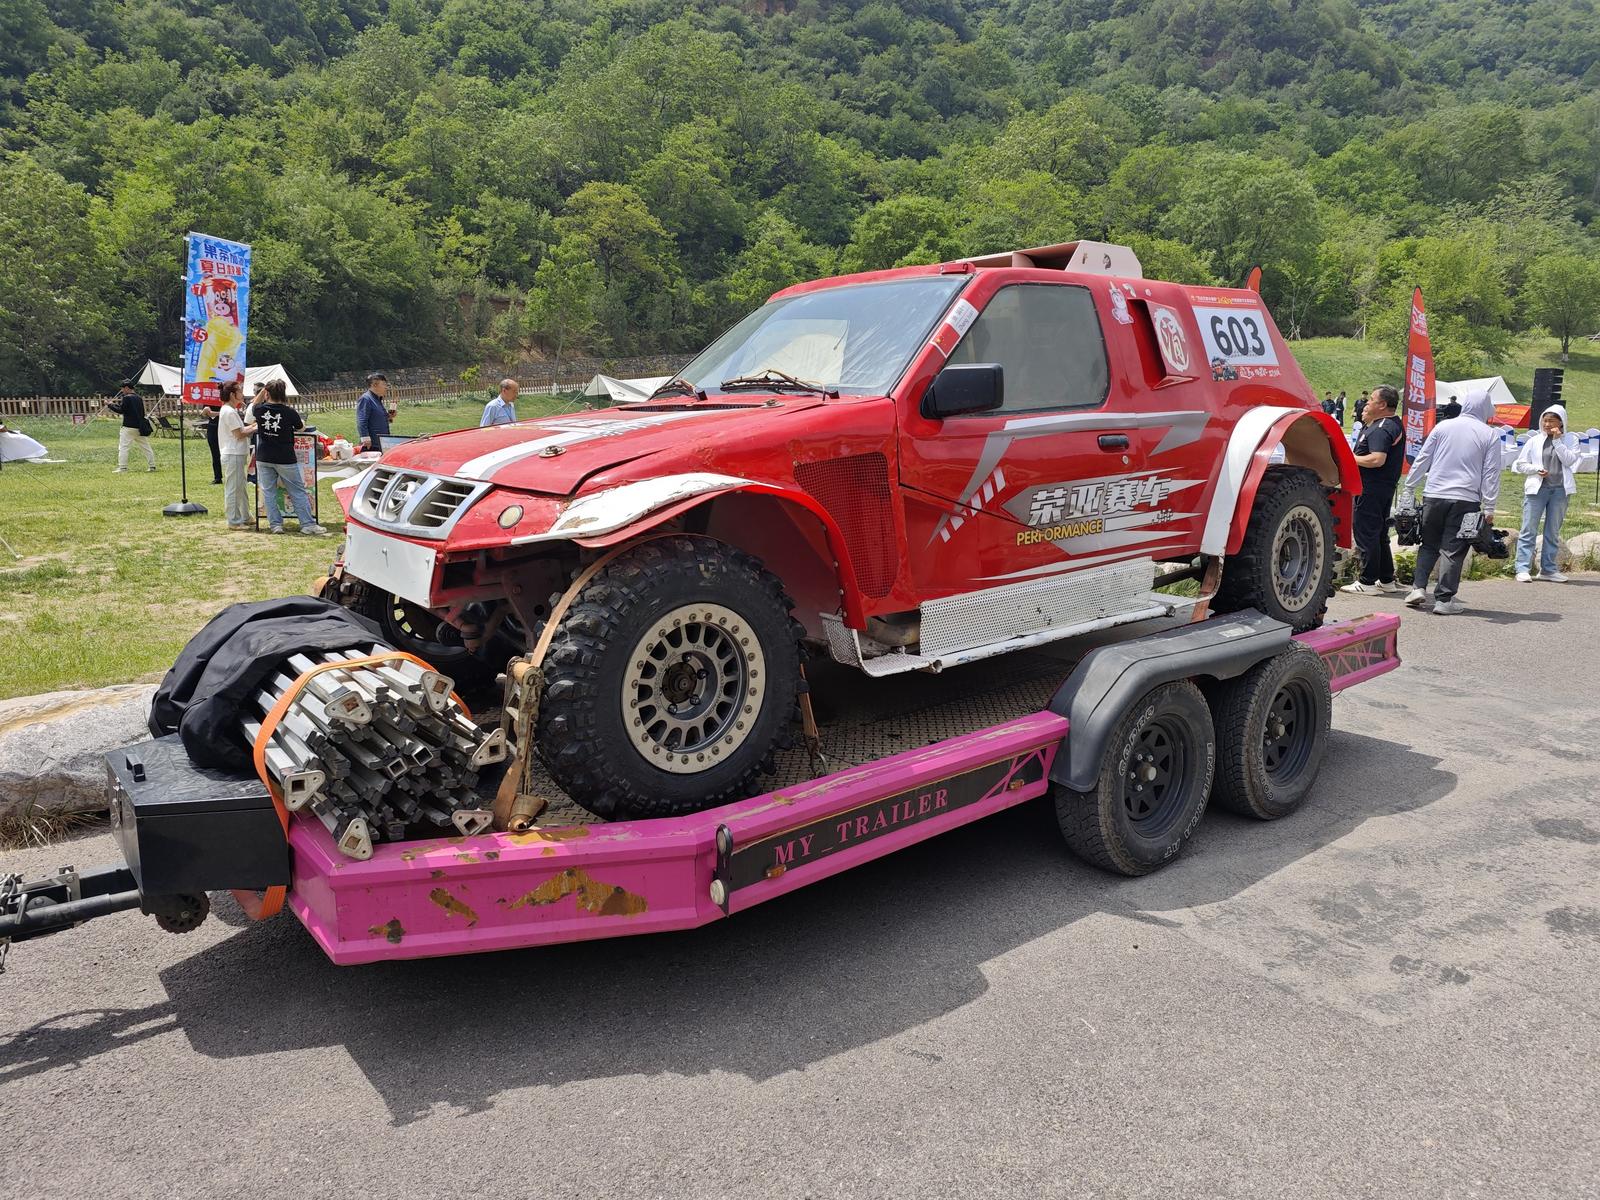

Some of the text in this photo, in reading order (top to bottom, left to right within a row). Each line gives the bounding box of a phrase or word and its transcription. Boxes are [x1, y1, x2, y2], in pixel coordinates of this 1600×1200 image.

[1210, 315, 1265, 356] 603
[1027, 475, 1172, 526] 荣亚赛车
